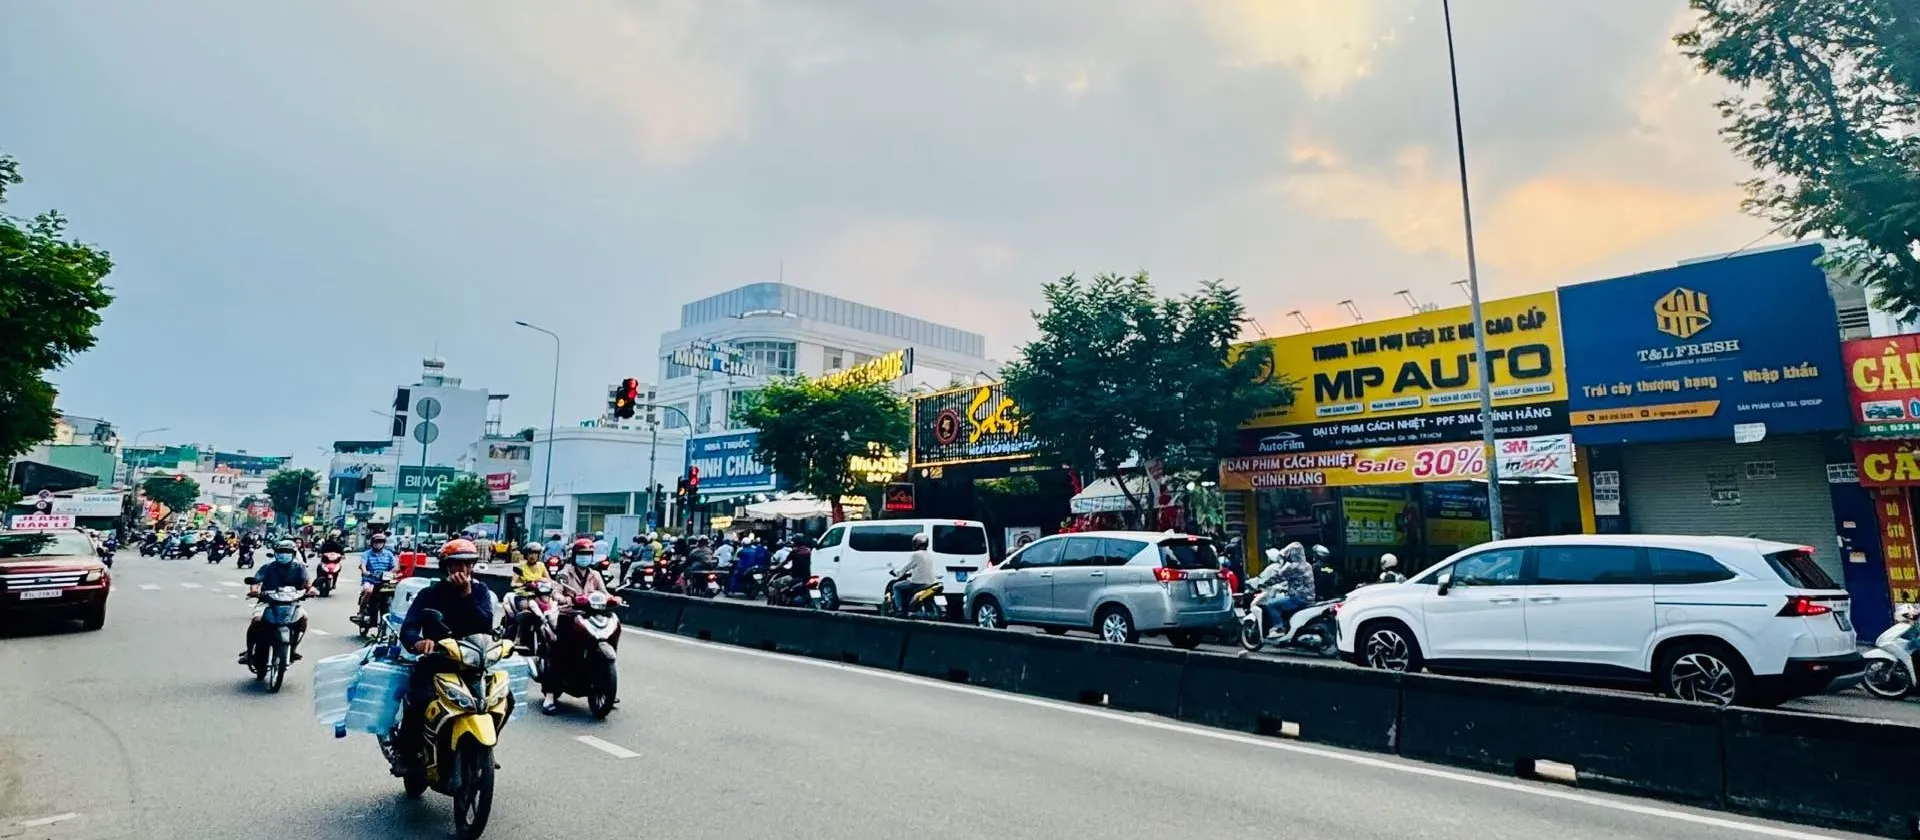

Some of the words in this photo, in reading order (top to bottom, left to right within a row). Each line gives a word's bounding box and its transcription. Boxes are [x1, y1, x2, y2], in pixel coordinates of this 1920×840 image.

[1438, 326, 1457, 343] XE
[1485, 317, 1513, 336] CAO
[674, 348, 713, 370] MINH
[1637, 349, 1674, 362] T&L
[1676, 339, 1740, 358] FRESH
[1313, 366, 1385, 403] MP
[1392, 343, 1552, 394] AUTO
[1611, 382, 1632, 396] cây
[1637, 379, 1680, 393] thượng
[1684, 376, 1717, 391] hạng
[1742, 367, 1779, 384] Nhập
[1313, 427, 1328, 438] ĐẠI
[1329, 424, 1339, 435] LÝ
[1341, 424, 1364, 435] PHIM
[1367, 419, 1394, 432] CÁCH
[1397, 416, 1426, 431] NHIỆT
[1436, 415, 1455, 426] PPF
[1458, 413, 1475, 424] 3M
[1515, 406, 1552, 418] HÃNG
[1258, 440, 1305, 452] AutoFilm
[1502, 440, 1528, 454] 3M
[1253, 458, 1280, 471] PHIM
[1283, 456, 1315, 469] CÁCH
[1318, 453, 1354, 468] NHIỆT
[1357, 459, 1406, 473] Sale
[1414, 447, 1483, 476] 30%
[405, 474, 435, 487] BIDV
[1252, 473, 1286, 487] CHÍNH
[1289, 472, 1322, 485] HÃNG
